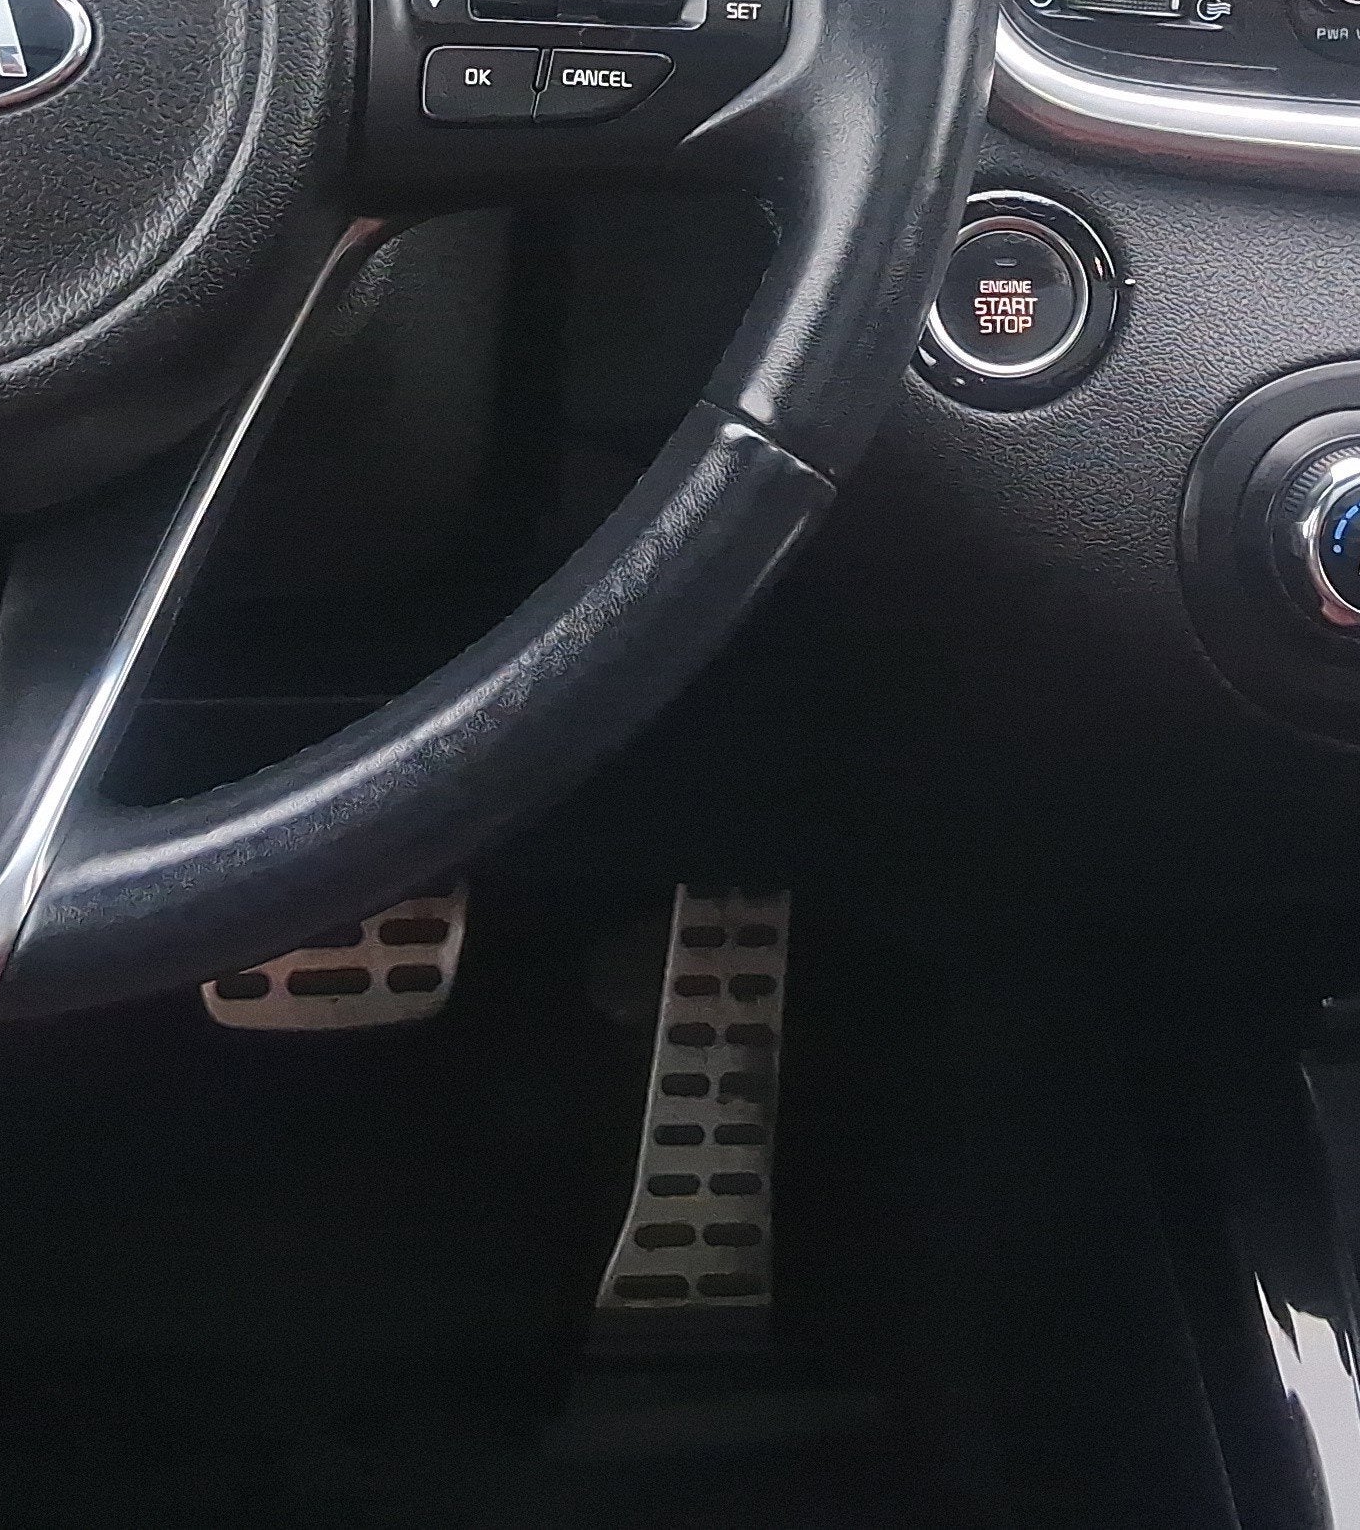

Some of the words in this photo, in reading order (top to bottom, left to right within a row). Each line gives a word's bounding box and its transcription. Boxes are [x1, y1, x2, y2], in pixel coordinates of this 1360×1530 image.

[726, 3, 761, 20] SET
[1316, 27, 1349, 41] PWR
[465, 69, 491, 86] OK
[562, 69, 633, 88] CANCEL
[979, 280, 1032, 294] ENGINE
[974, 298, 1038, 315] START
[979, 316, 1032, 333] STOP
